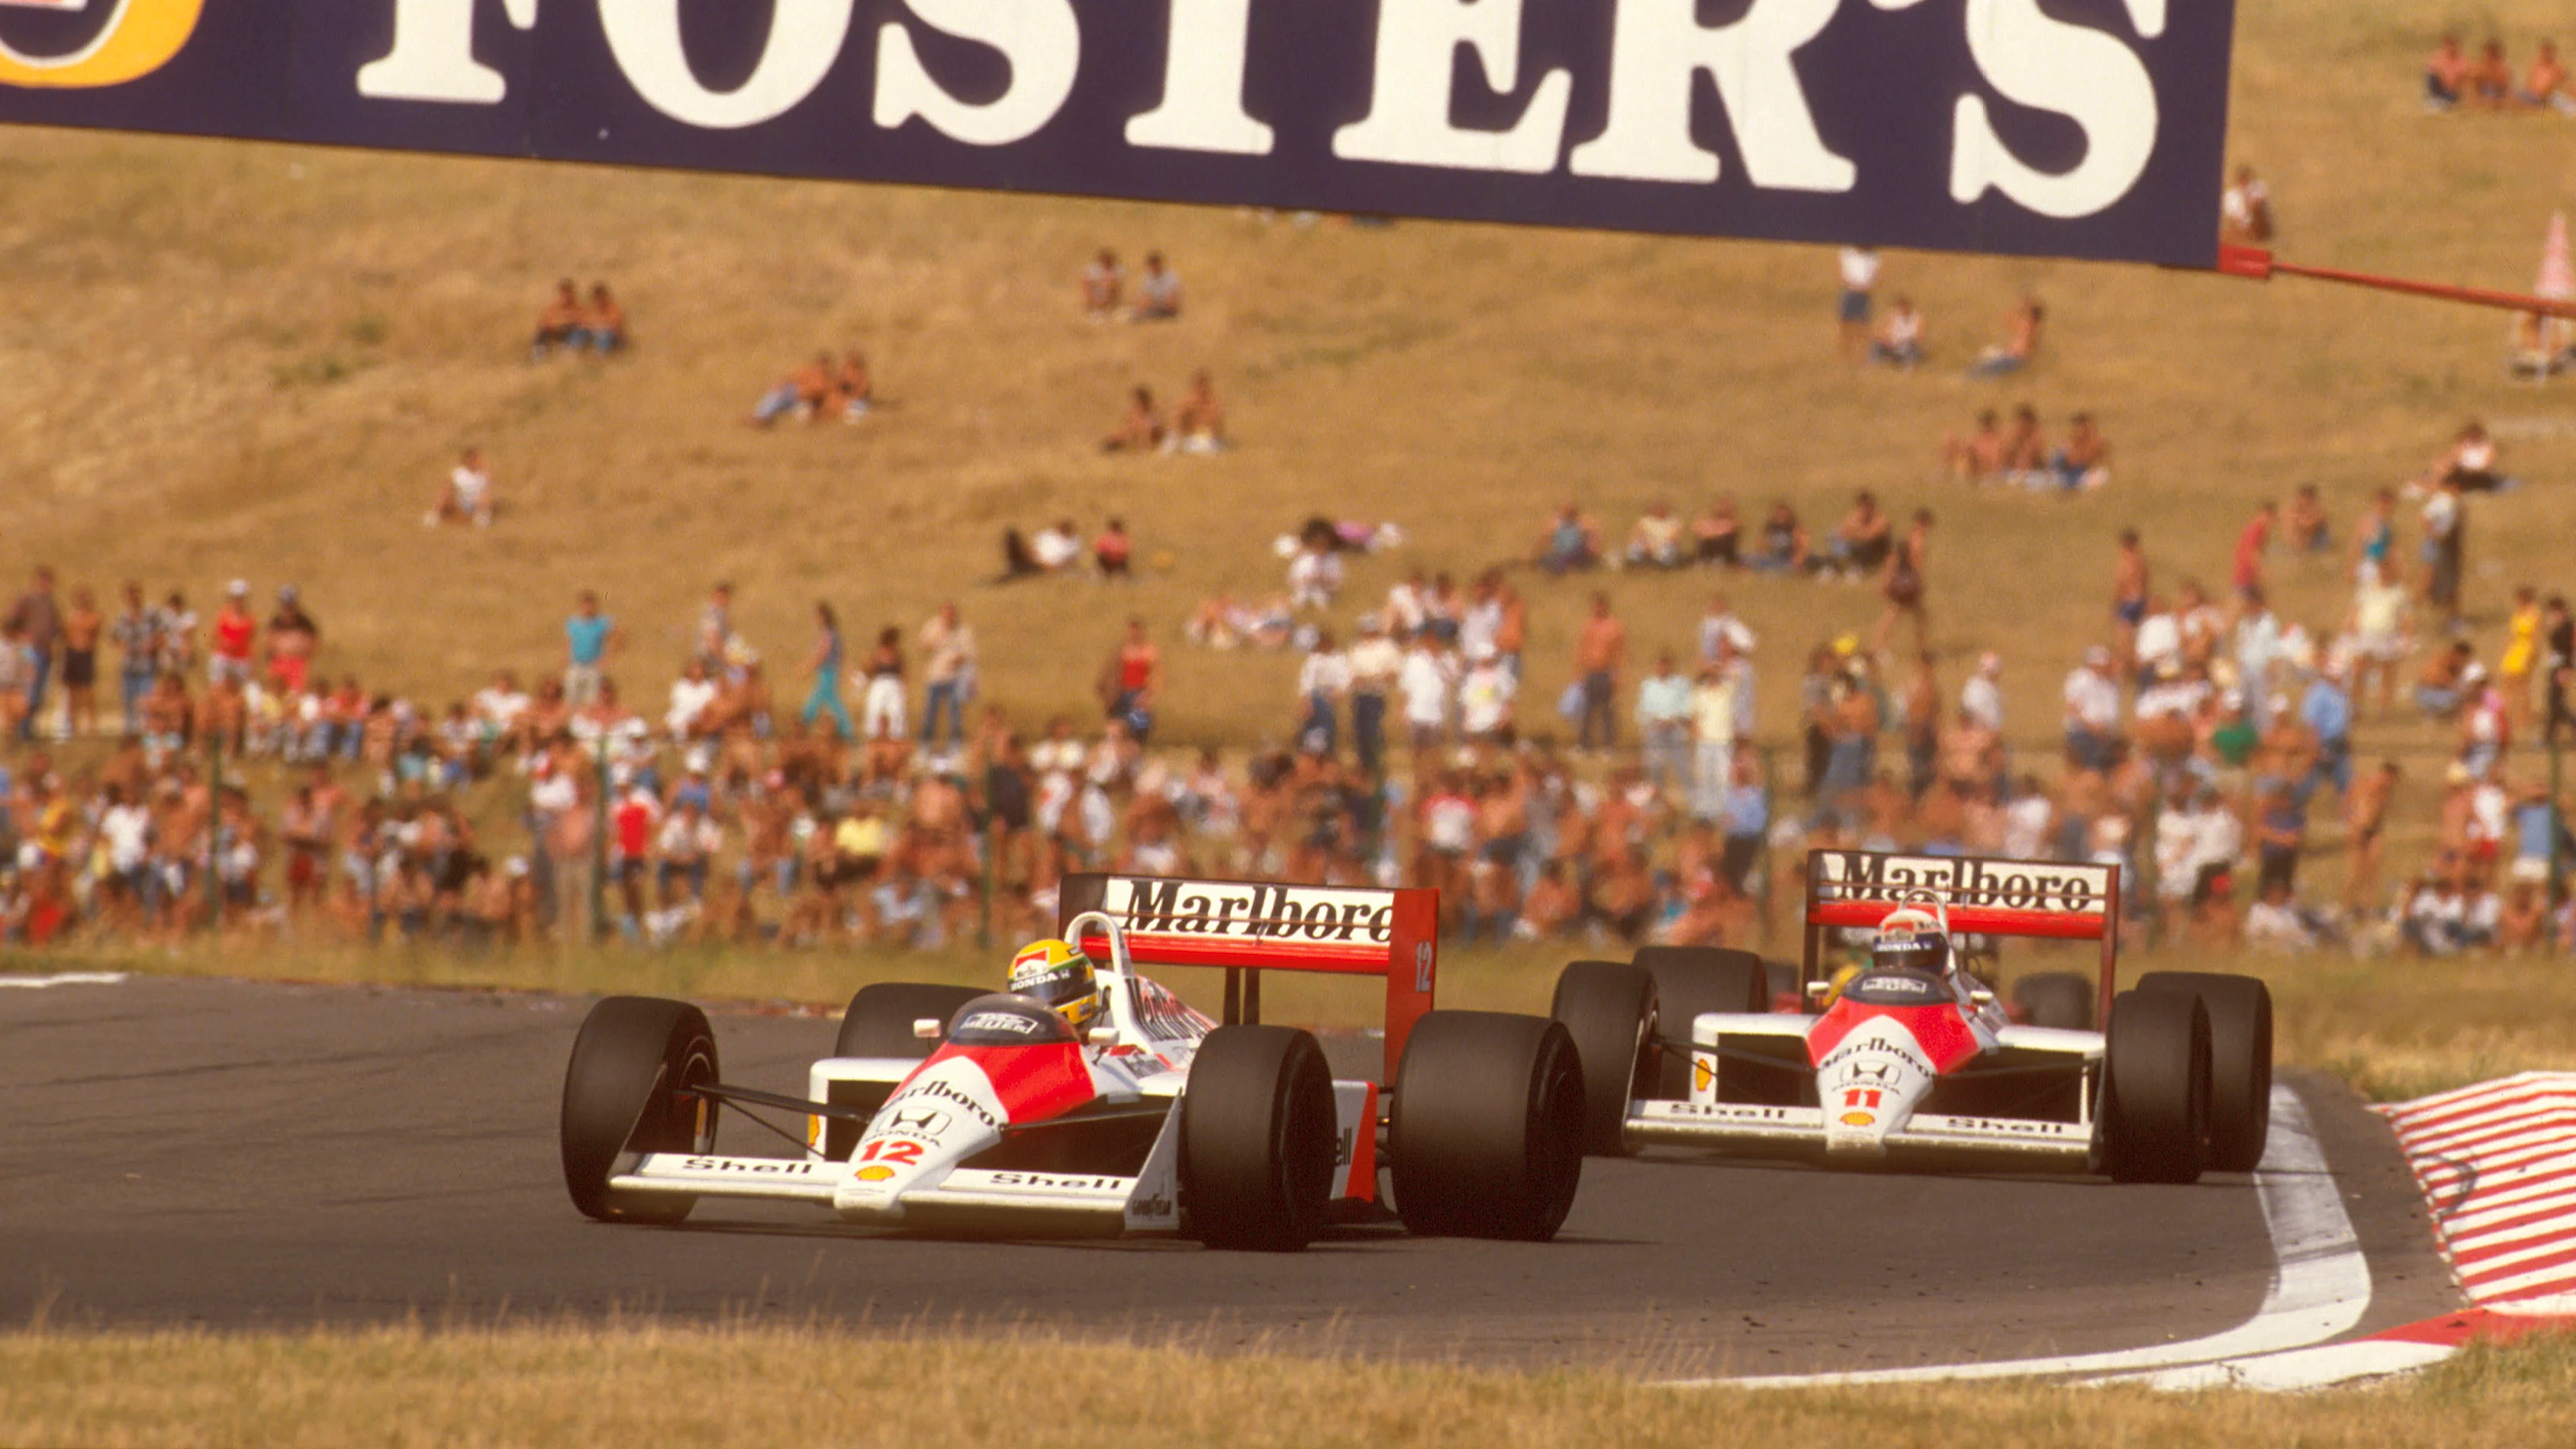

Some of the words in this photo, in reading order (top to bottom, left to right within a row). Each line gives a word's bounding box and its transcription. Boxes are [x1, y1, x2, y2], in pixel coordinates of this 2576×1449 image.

[356, 0, 2164, 218] STERS
[1840, 853, 2090, 910] Marlboro
[1124, 879, 1392, 943] Marlboro
[1416, 940, 1433, 993] 12
[1842, 1088, 1883, 1109] 11
[1671, 1104, 1785, 1119] Shell
[1947, 1118, 2063, 1133] Shell
[859, 1140, 924, 1166] 12
[683, 1158, 813, 1174] Shell
[990, 1173, 1121, 1189] Shell
